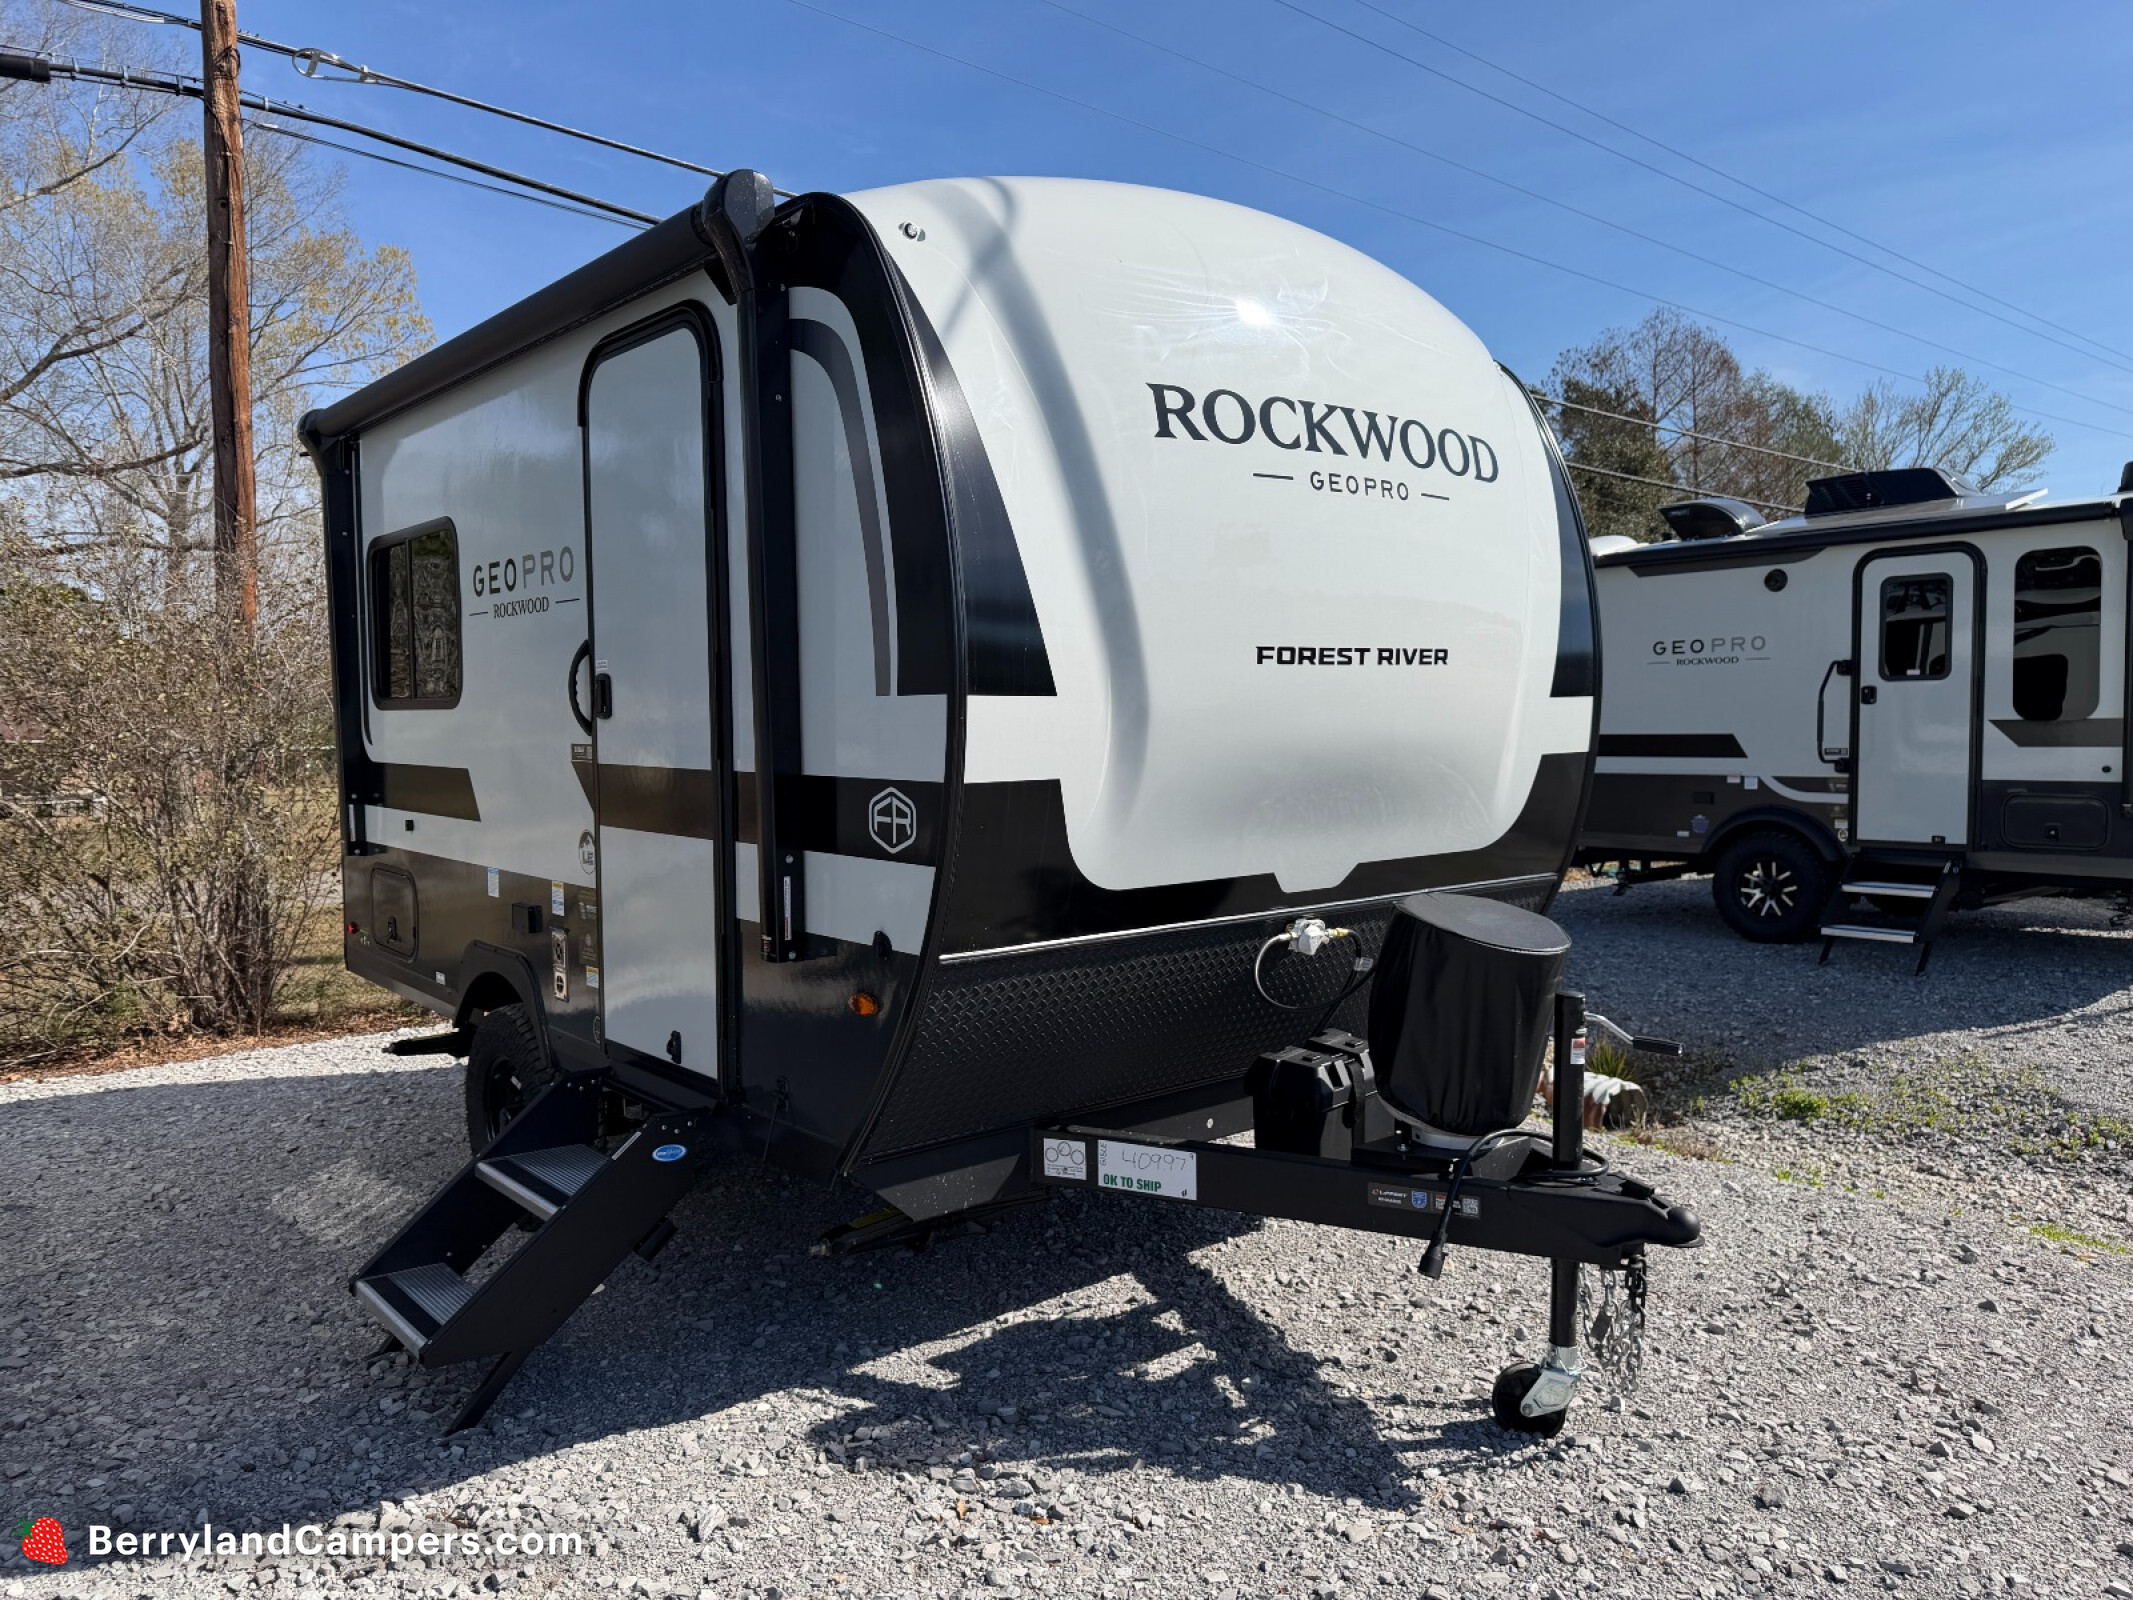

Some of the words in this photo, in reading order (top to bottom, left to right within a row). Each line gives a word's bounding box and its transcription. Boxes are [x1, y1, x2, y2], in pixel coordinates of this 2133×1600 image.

[1145, 382, 1499, 483] ROCKWOOD
[1309, 470, 1409, 500] GEOPRO
[473, 546, 574, 597] GEOPRO
[493, 596, 550, 619] ROCKWOOD
[1256, 646, 1371, 665] FOREST
[1376, 647, 1449, 665] RIVER
[1652, 635, 1766, 656] GEOPRO
[1676, 656, 1740, 666] ROCKWOOD
[1121, 1148, 1186, 1171] 40997
[1103, 1173, 1118, 1186] OK
[1120, 1176, 1134, 1189] TO
[1136, 1178, 1162, 1192] SHIP
